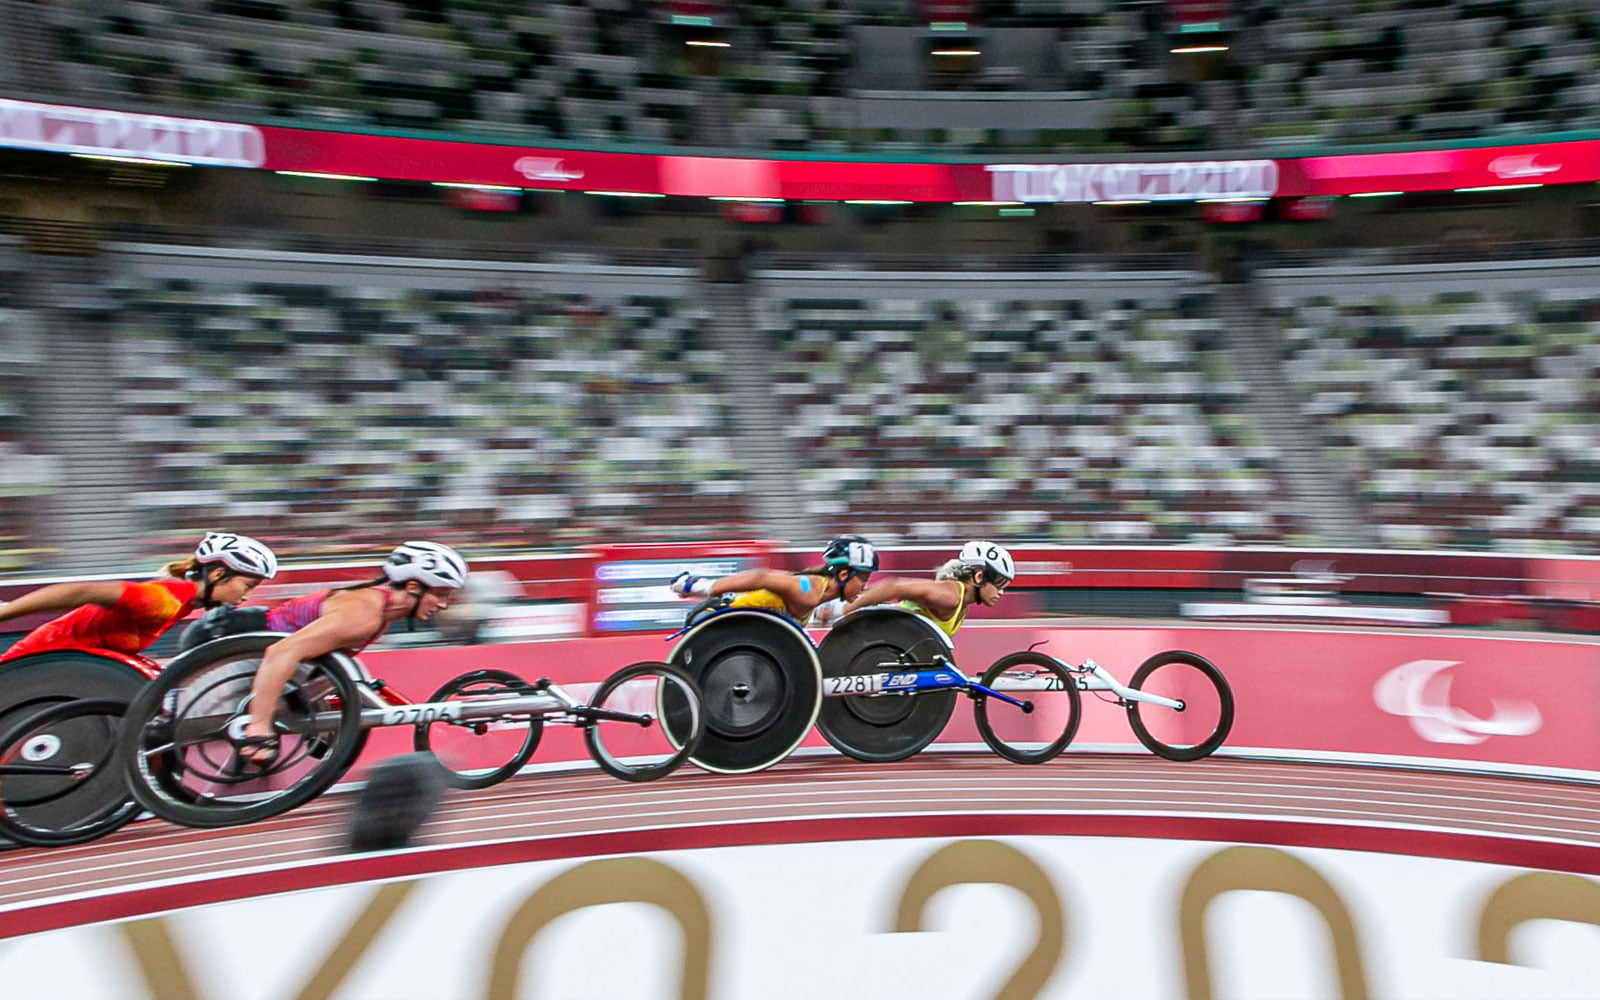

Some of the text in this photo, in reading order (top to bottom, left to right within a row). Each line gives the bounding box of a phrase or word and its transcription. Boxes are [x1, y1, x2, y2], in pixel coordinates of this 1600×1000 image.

[220, 535, 239, 551] 2
[421, 552, 437, 571] 3
[857, 545, 866, 563] 1
[986, 546, 998, 561] 6
[831, 675, 875, 694] 2281
[1045, 677, 1088, 691] 205
